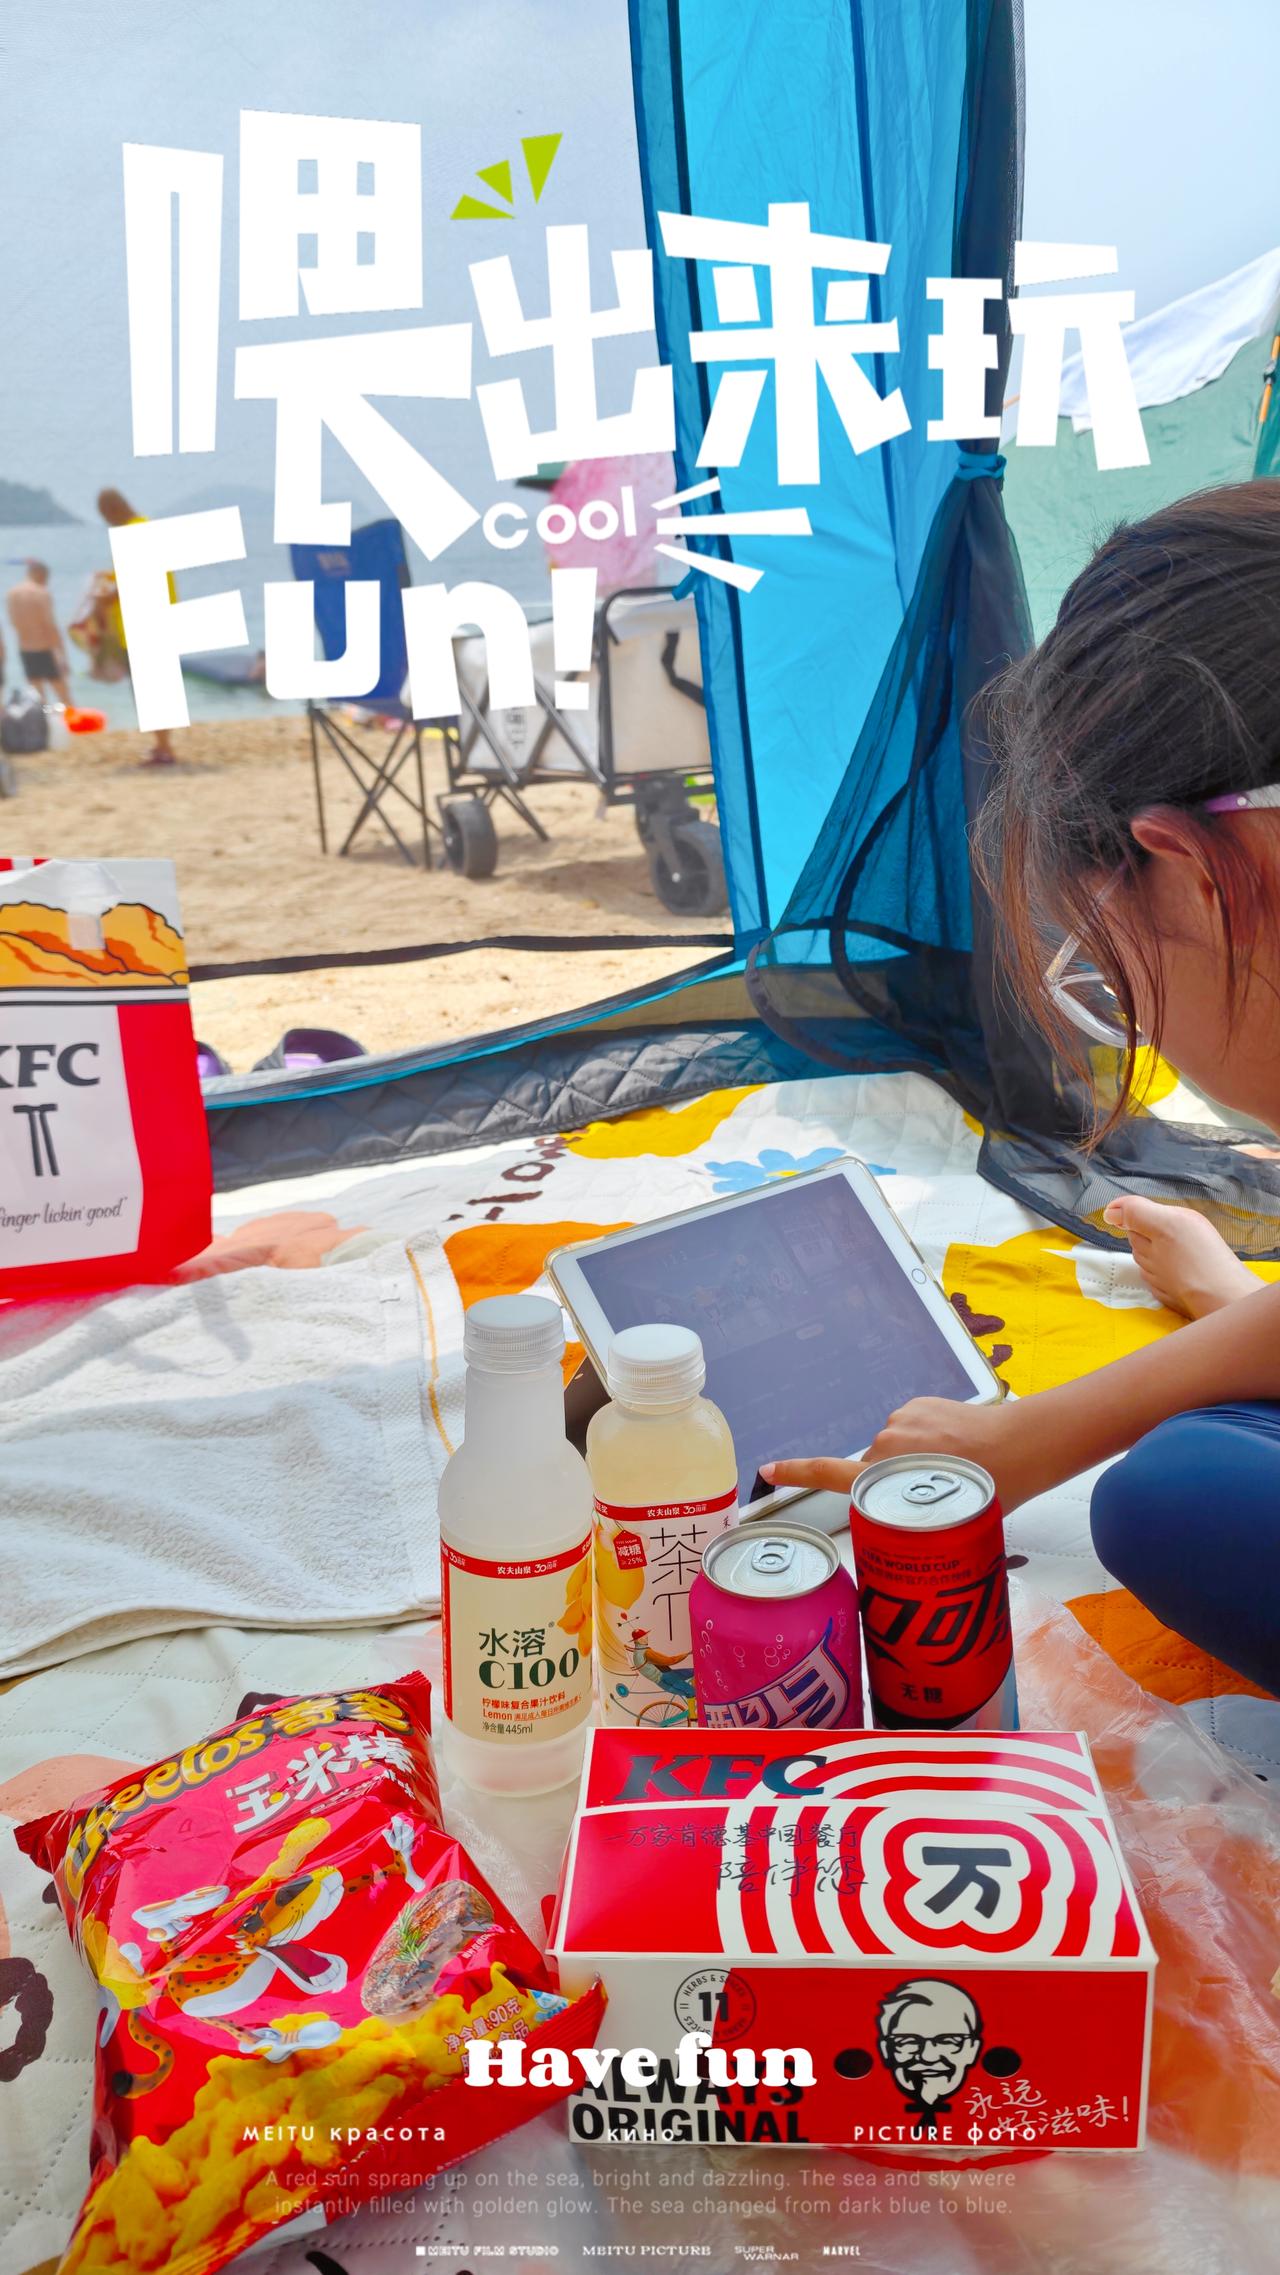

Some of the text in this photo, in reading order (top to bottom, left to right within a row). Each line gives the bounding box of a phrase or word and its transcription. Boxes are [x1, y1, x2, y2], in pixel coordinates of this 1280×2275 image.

[0, 1043, 101, 1088] FC
[647, 1507, 681, 1518] 农夫山泉
[617, 1544, 642, 1557] 减糖
[885, 1560, 932, 1572] WORLD
[934, 1559, 961, 1571] CUP
[497, 1566, 532, 1576] 农夫山泉
[478, 1627, 547, 1659] 水溶
[478, 1647, 580, 1691] C100
[902, 1683, 943, 1703] 无糖
[483, 1708, 513, 1721] Lemon
[614, 1754, 829, 1801] KFC
[601, 1822, 858, 1849] 一万家肯德基中国餐厅
[714, 1855, 869, 1897] 陪伴您
[698, 1991, 730, 2022] 11
[964, 2079, 1048, 2120] 永远
[572, 2102, 810, 2143] ORIGINAL
